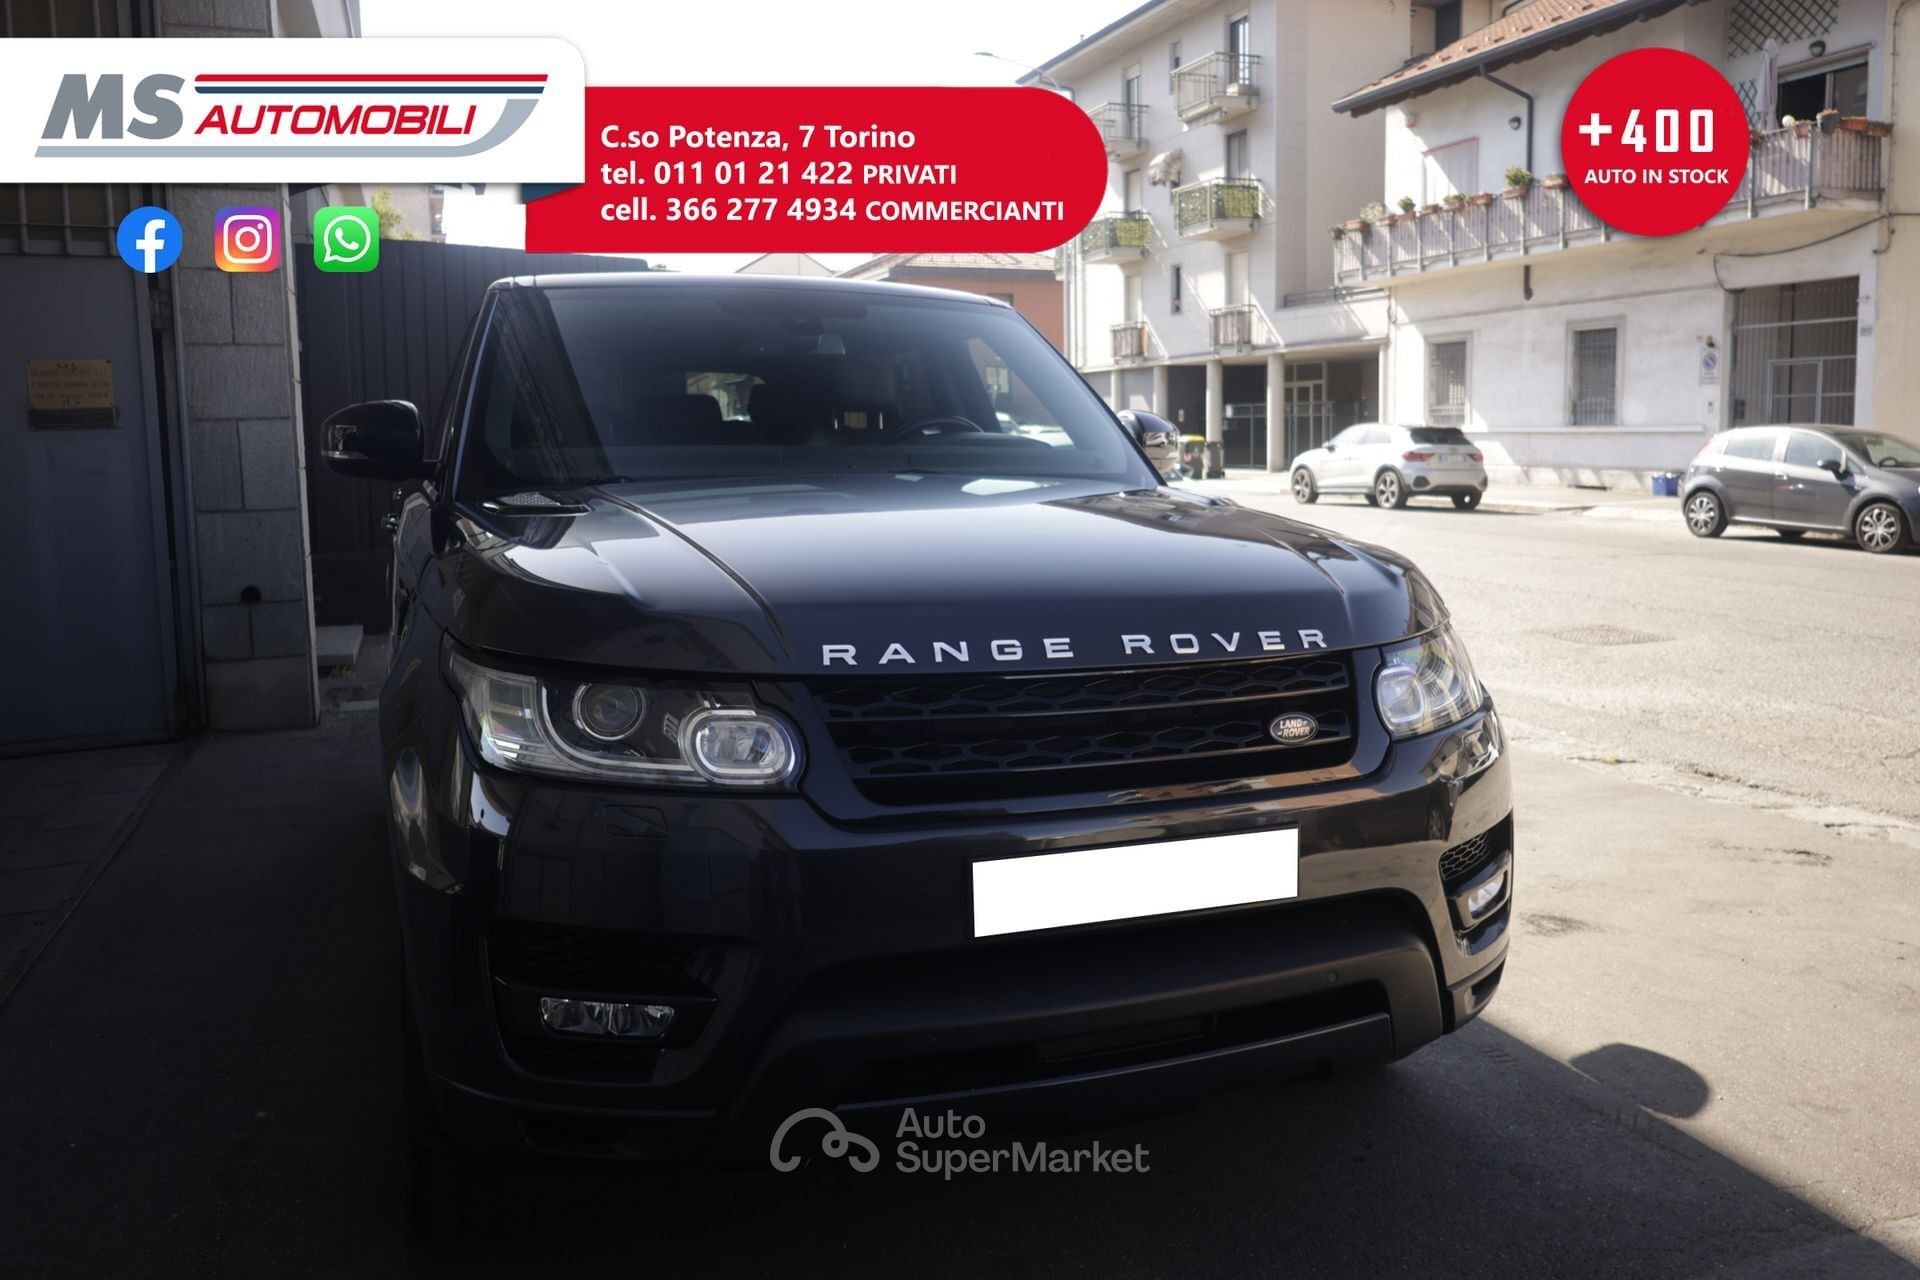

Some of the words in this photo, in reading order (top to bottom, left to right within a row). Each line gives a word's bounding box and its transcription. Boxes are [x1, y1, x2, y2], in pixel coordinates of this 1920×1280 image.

[822, 637, 1074, 666] RANGE
[1121, 628, 1328, 656] ROVER
[1280, 718, 1303, 729] LAND
[1283, 727, 1310, 738] ROVER
